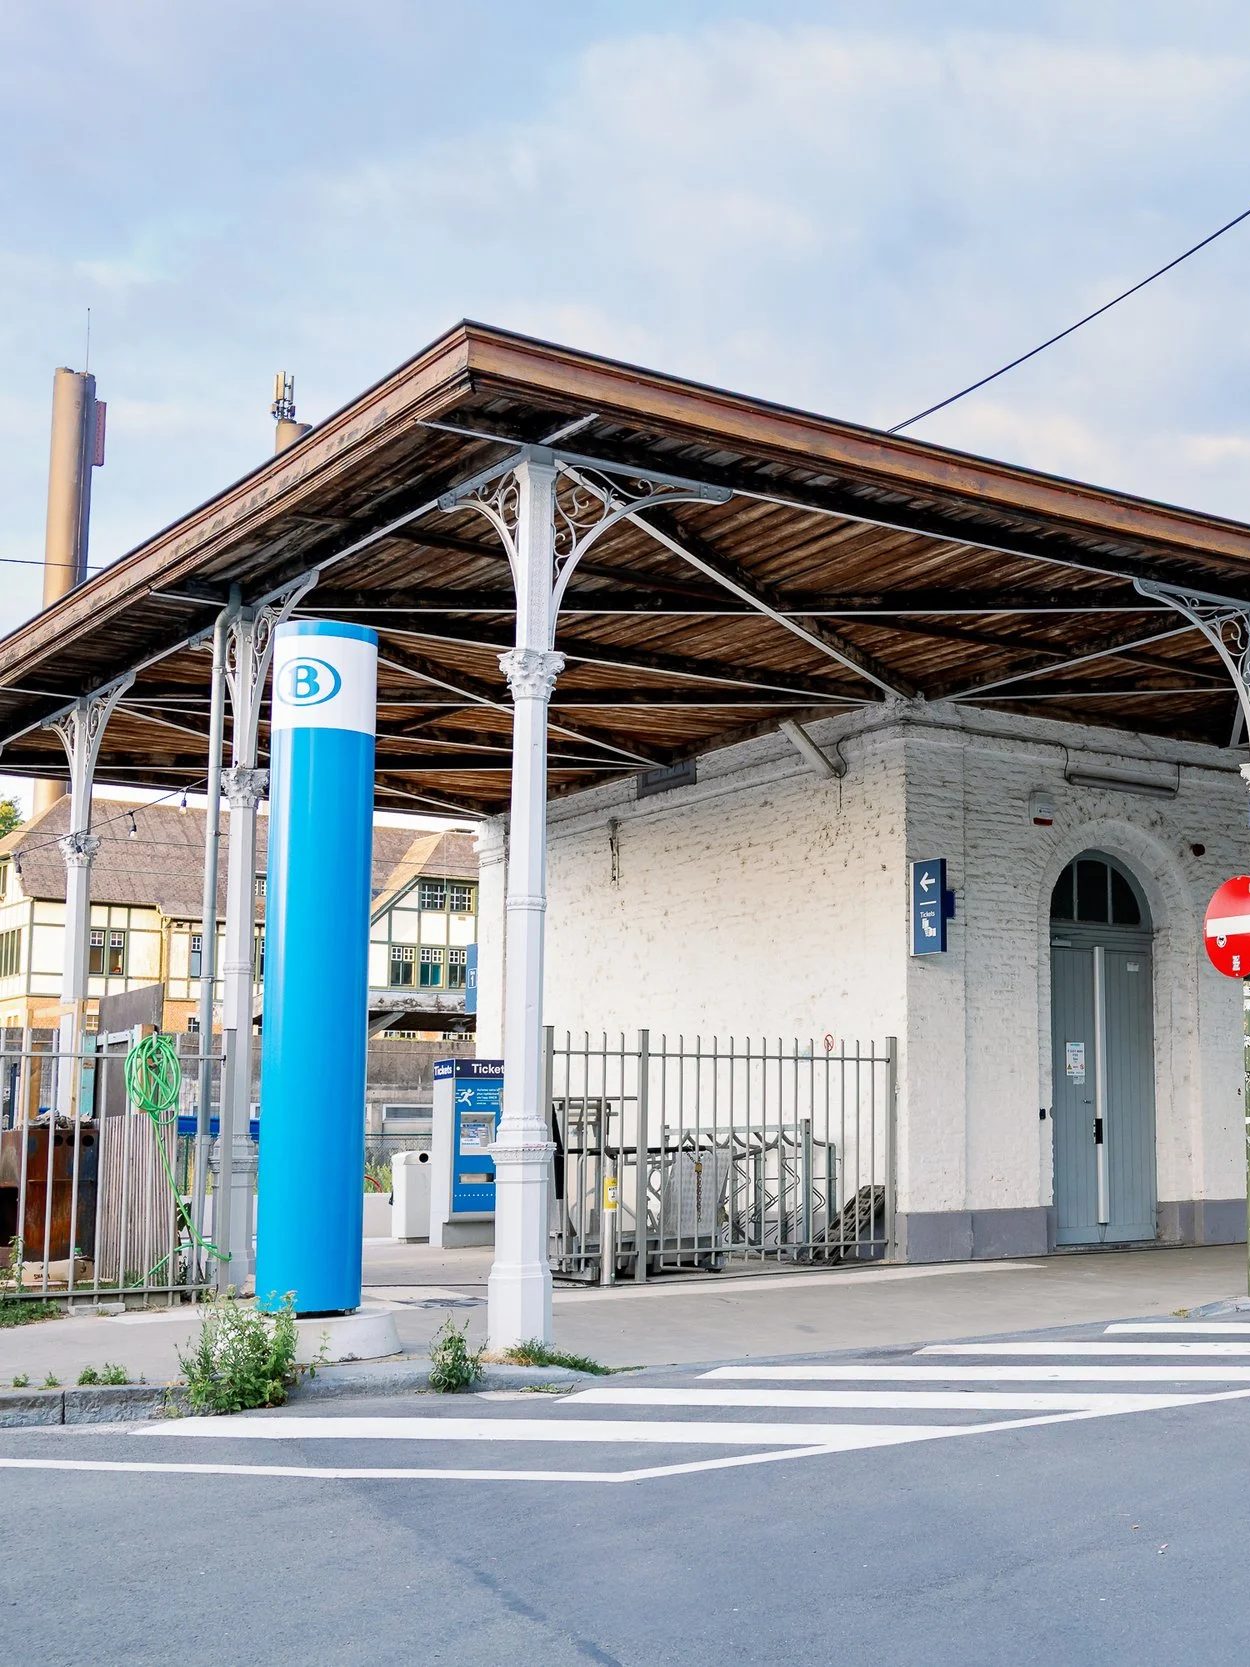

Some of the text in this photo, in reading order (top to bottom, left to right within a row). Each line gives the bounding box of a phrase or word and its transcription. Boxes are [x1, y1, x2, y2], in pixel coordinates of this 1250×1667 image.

[288, 665, 320, 698] B
[433, 1064, 453, 1076] Tickets
[471, 1063, 505, 1075] Ticket
